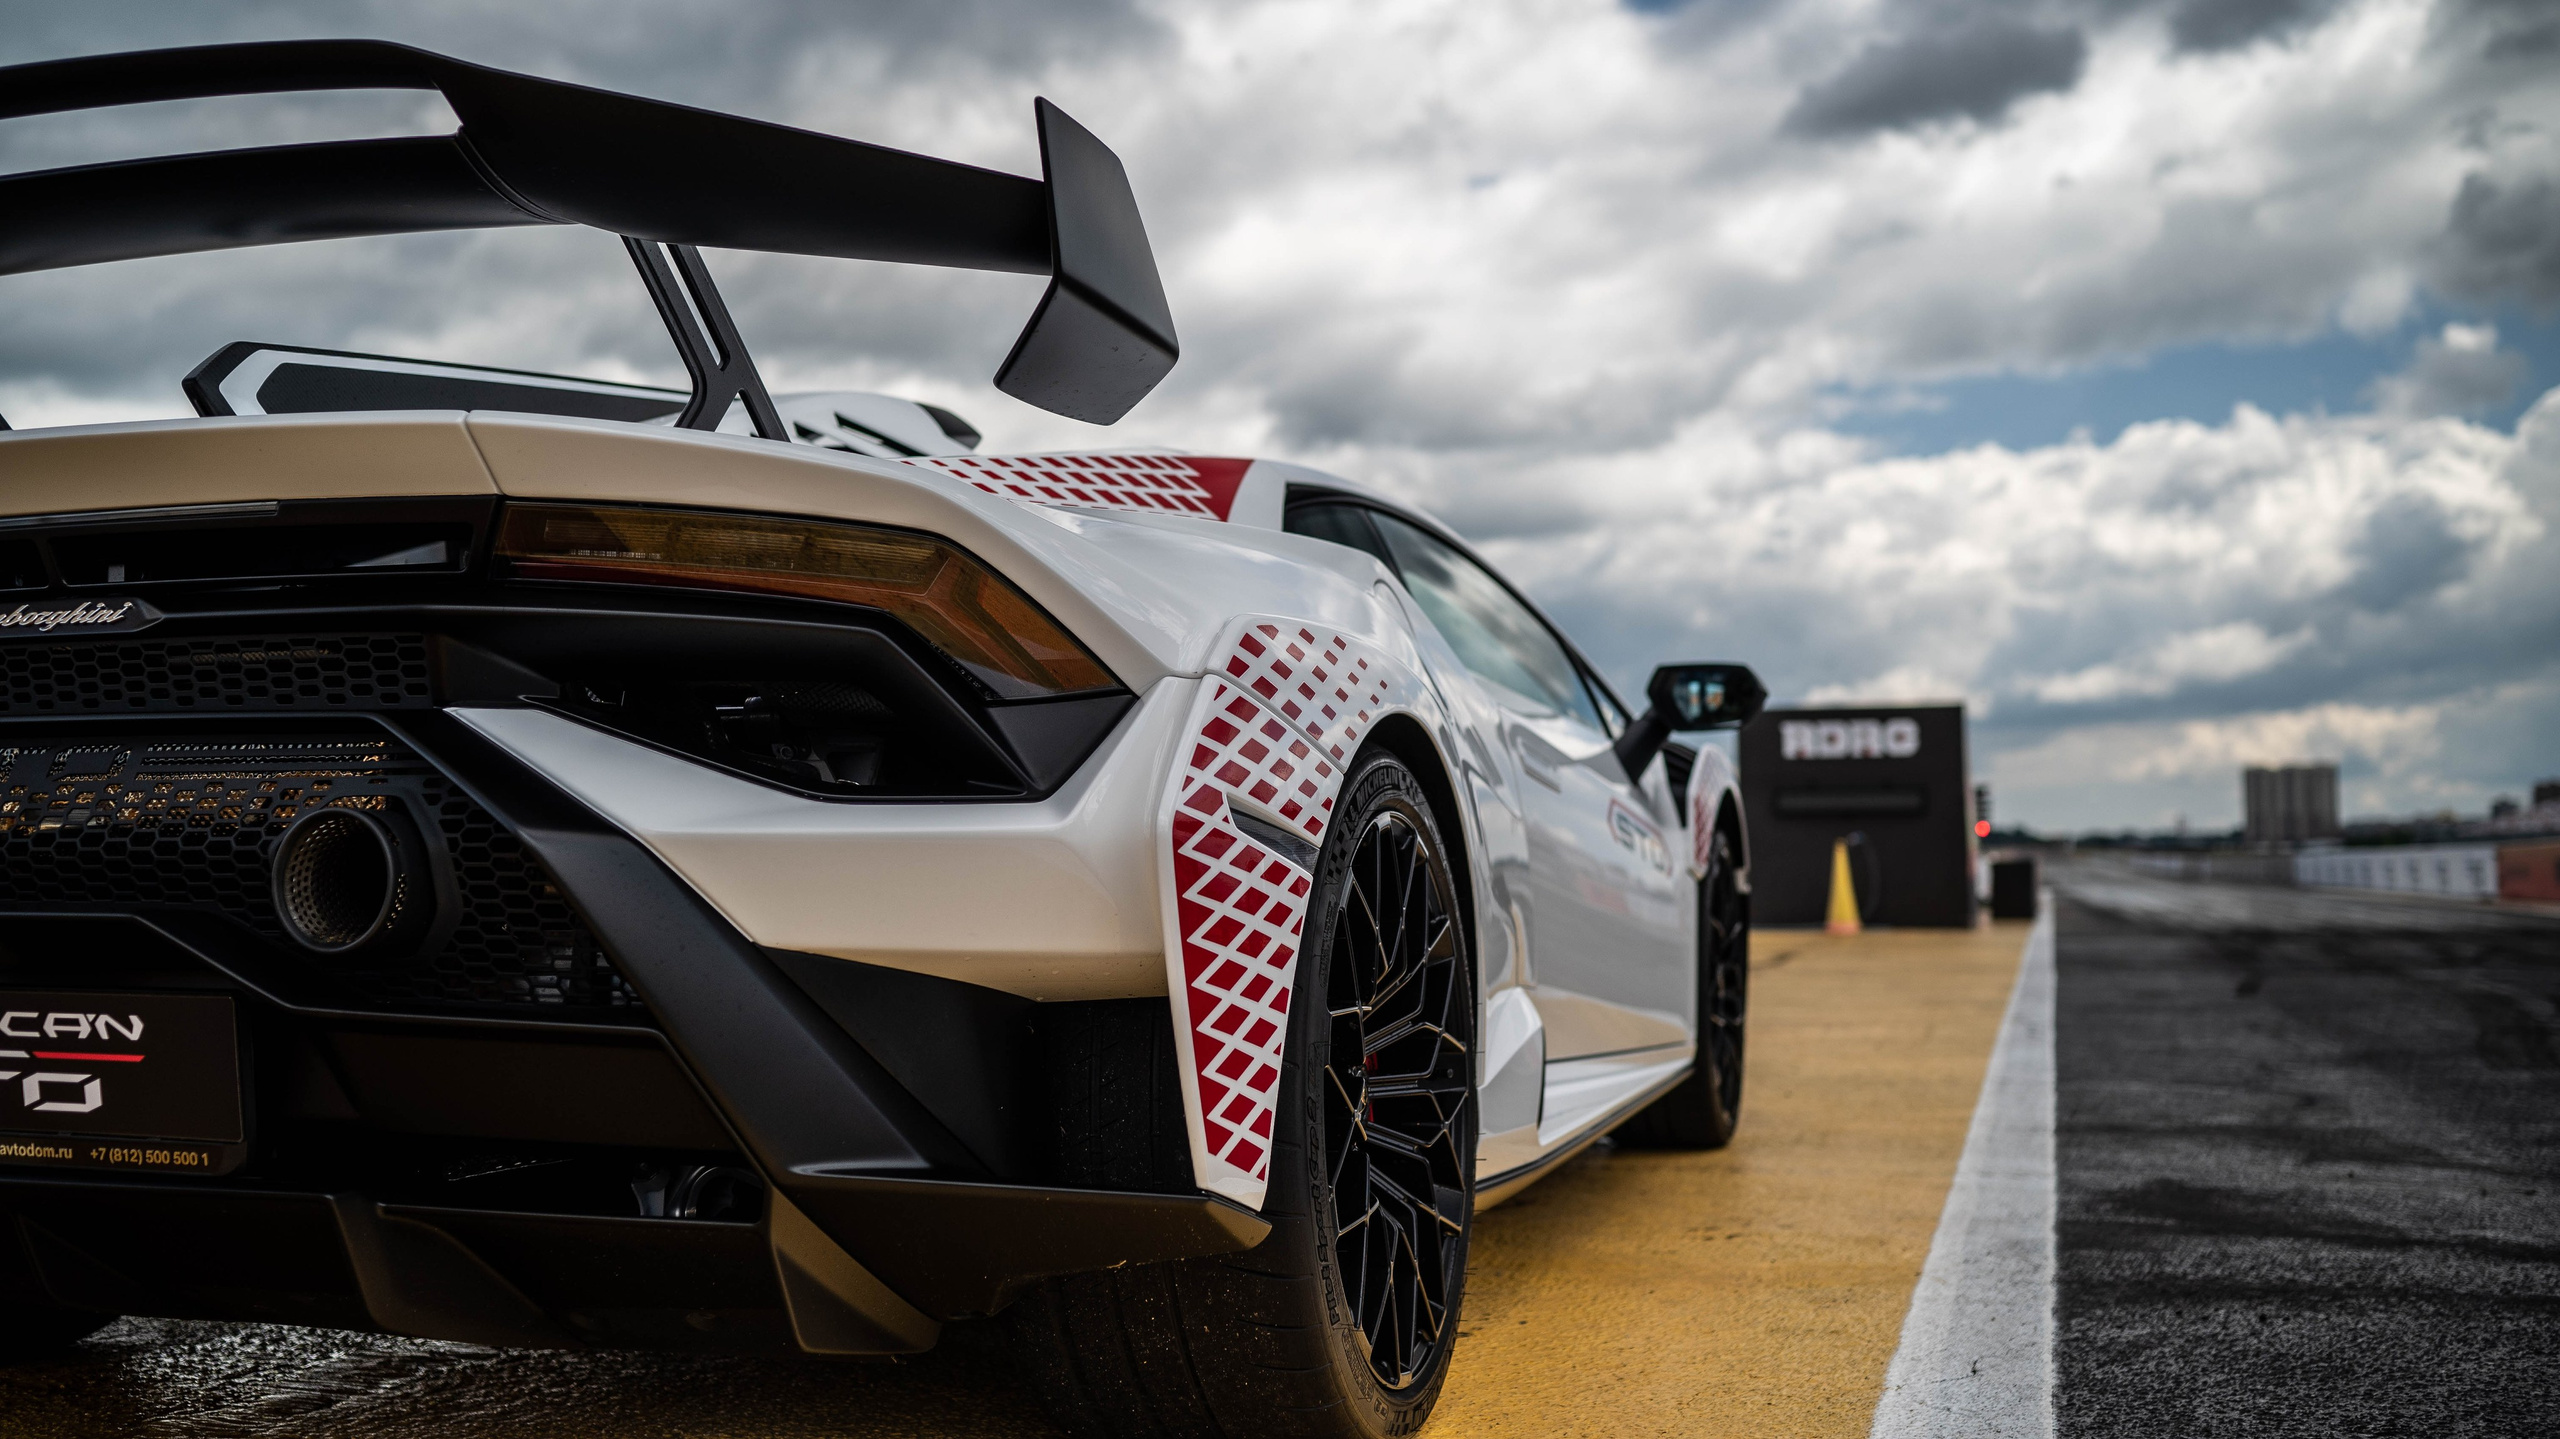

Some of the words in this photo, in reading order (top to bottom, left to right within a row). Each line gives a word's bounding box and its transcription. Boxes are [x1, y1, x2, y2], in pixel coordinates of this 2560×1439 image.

[91, 1148, 106, 1161] +7
[109, 1148, 142, 1166] (812)
[146, 1151, 170, 1165] 500
[173, 1152, 198, 1166] 500
[202, 1153, 209, 1167] 1
[1321, 1265, 1340, 1326] Pilot
